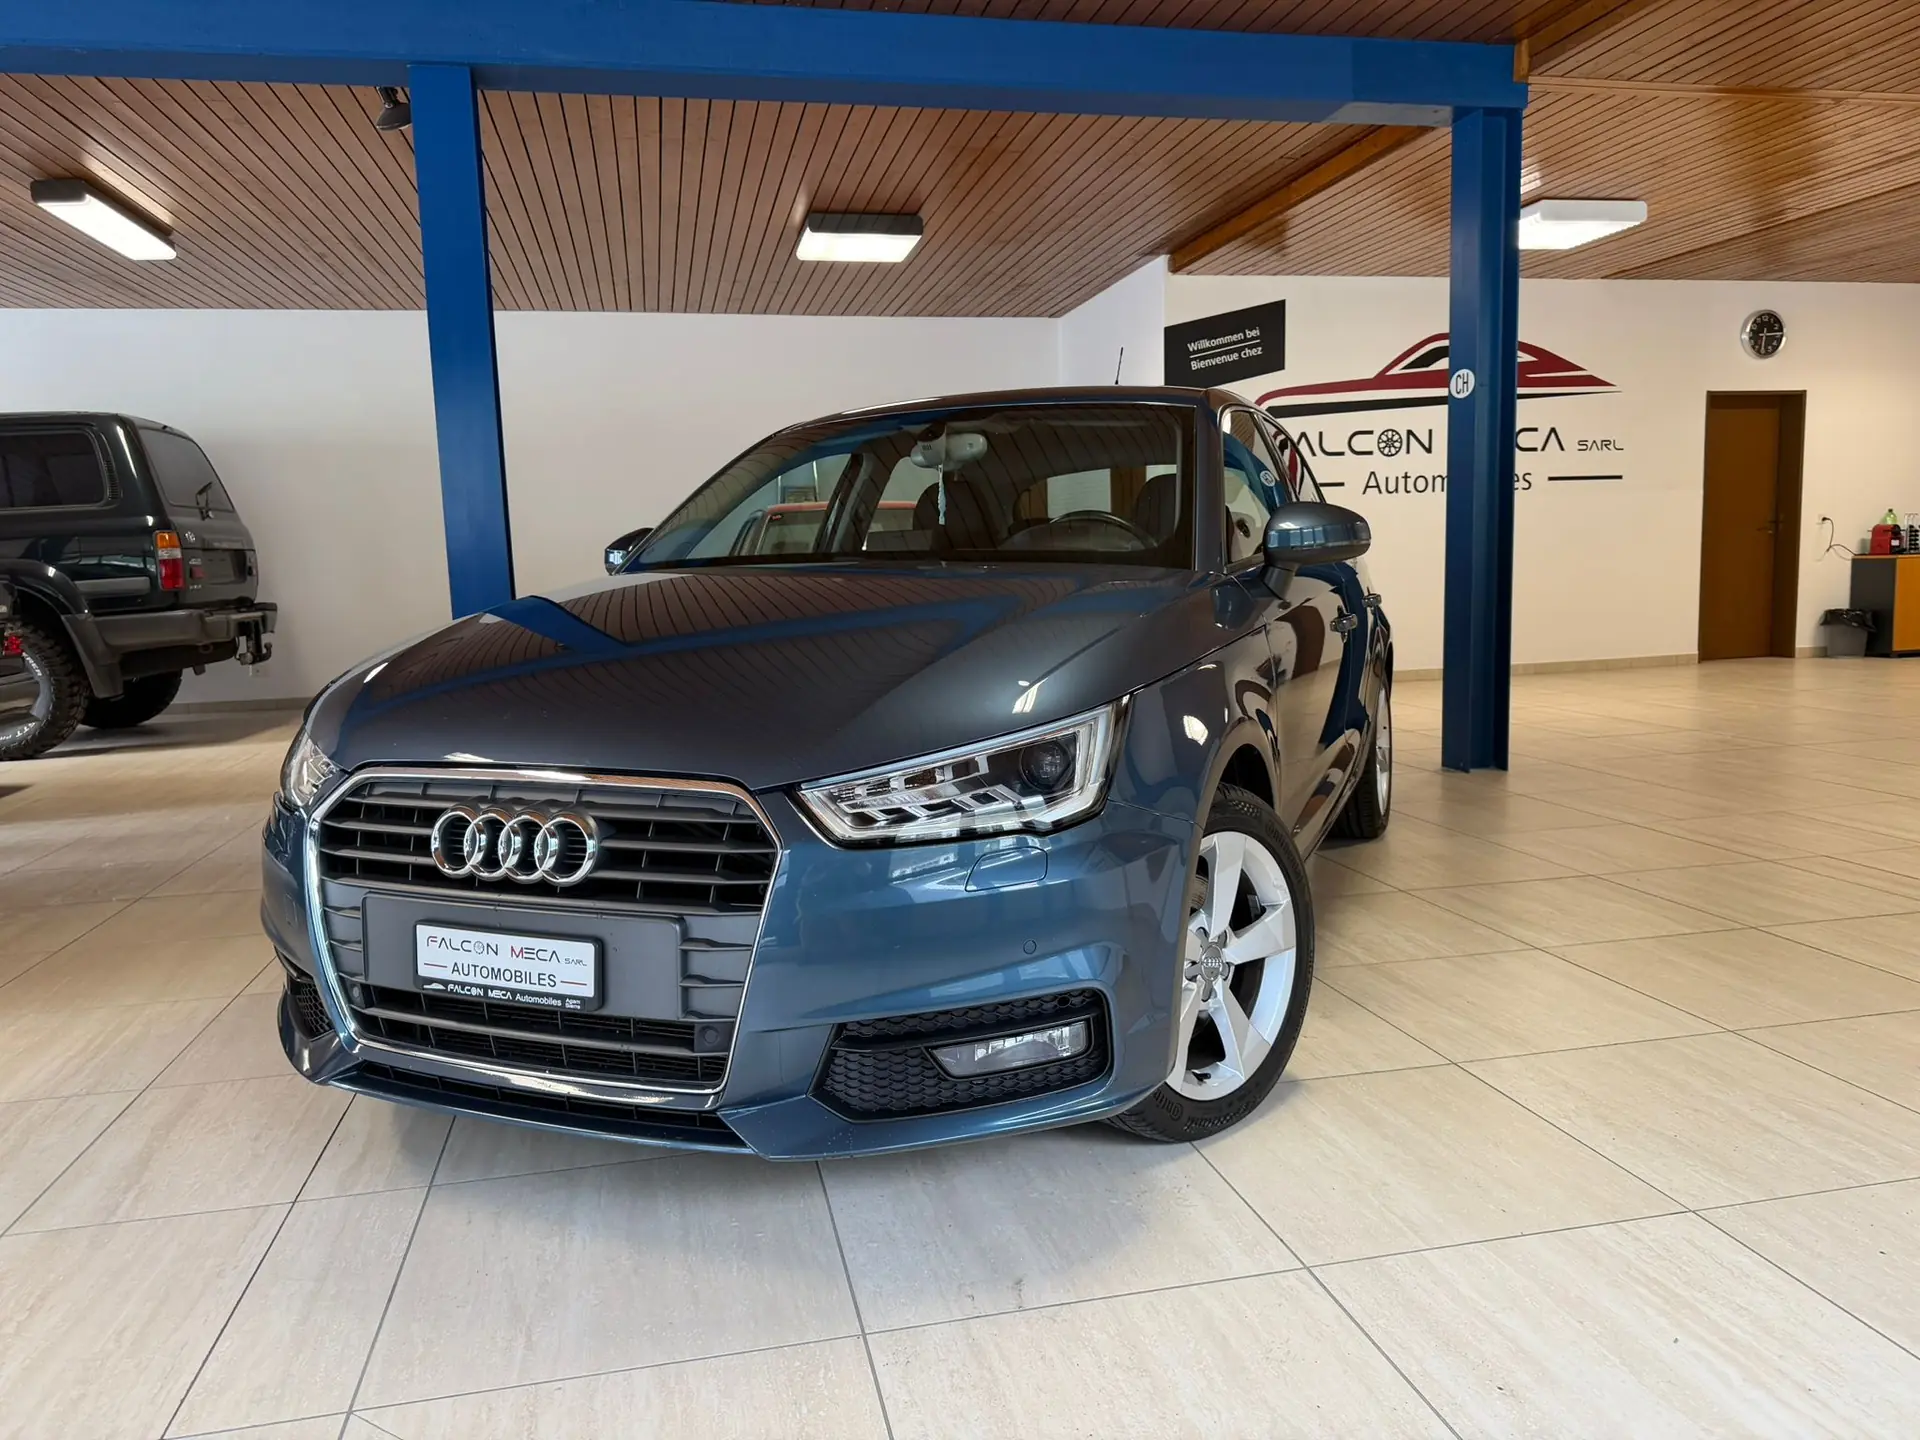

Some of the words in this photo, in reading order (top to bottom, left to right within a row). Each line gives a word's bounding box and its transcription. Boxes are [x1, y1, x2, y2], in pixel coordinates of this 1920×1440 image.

[1187, 332, 1244, 352] Willkommen
[1245, 327, 1260, 338] bei
[1190, 351, 1239, 370] Bienvenue
[1241, 346, 1262, 358] chez
[1456, 372, 1469, 394] CH
[1297, 428, 1432, 457] ALCON
[1515, 427, 1565, 452] CA
[1577, 439, 1624, 451] SARL
[427, 936, 498, 956] FALCON
[511, 945, 560, 963] MECA
[451, 962, 557, 988] AUTOMOBILES
[448, 983, 484, 996] FALCON
[488, 989, 512, 1000] MECA
[515, 993, 562, 1006] Automobiles
